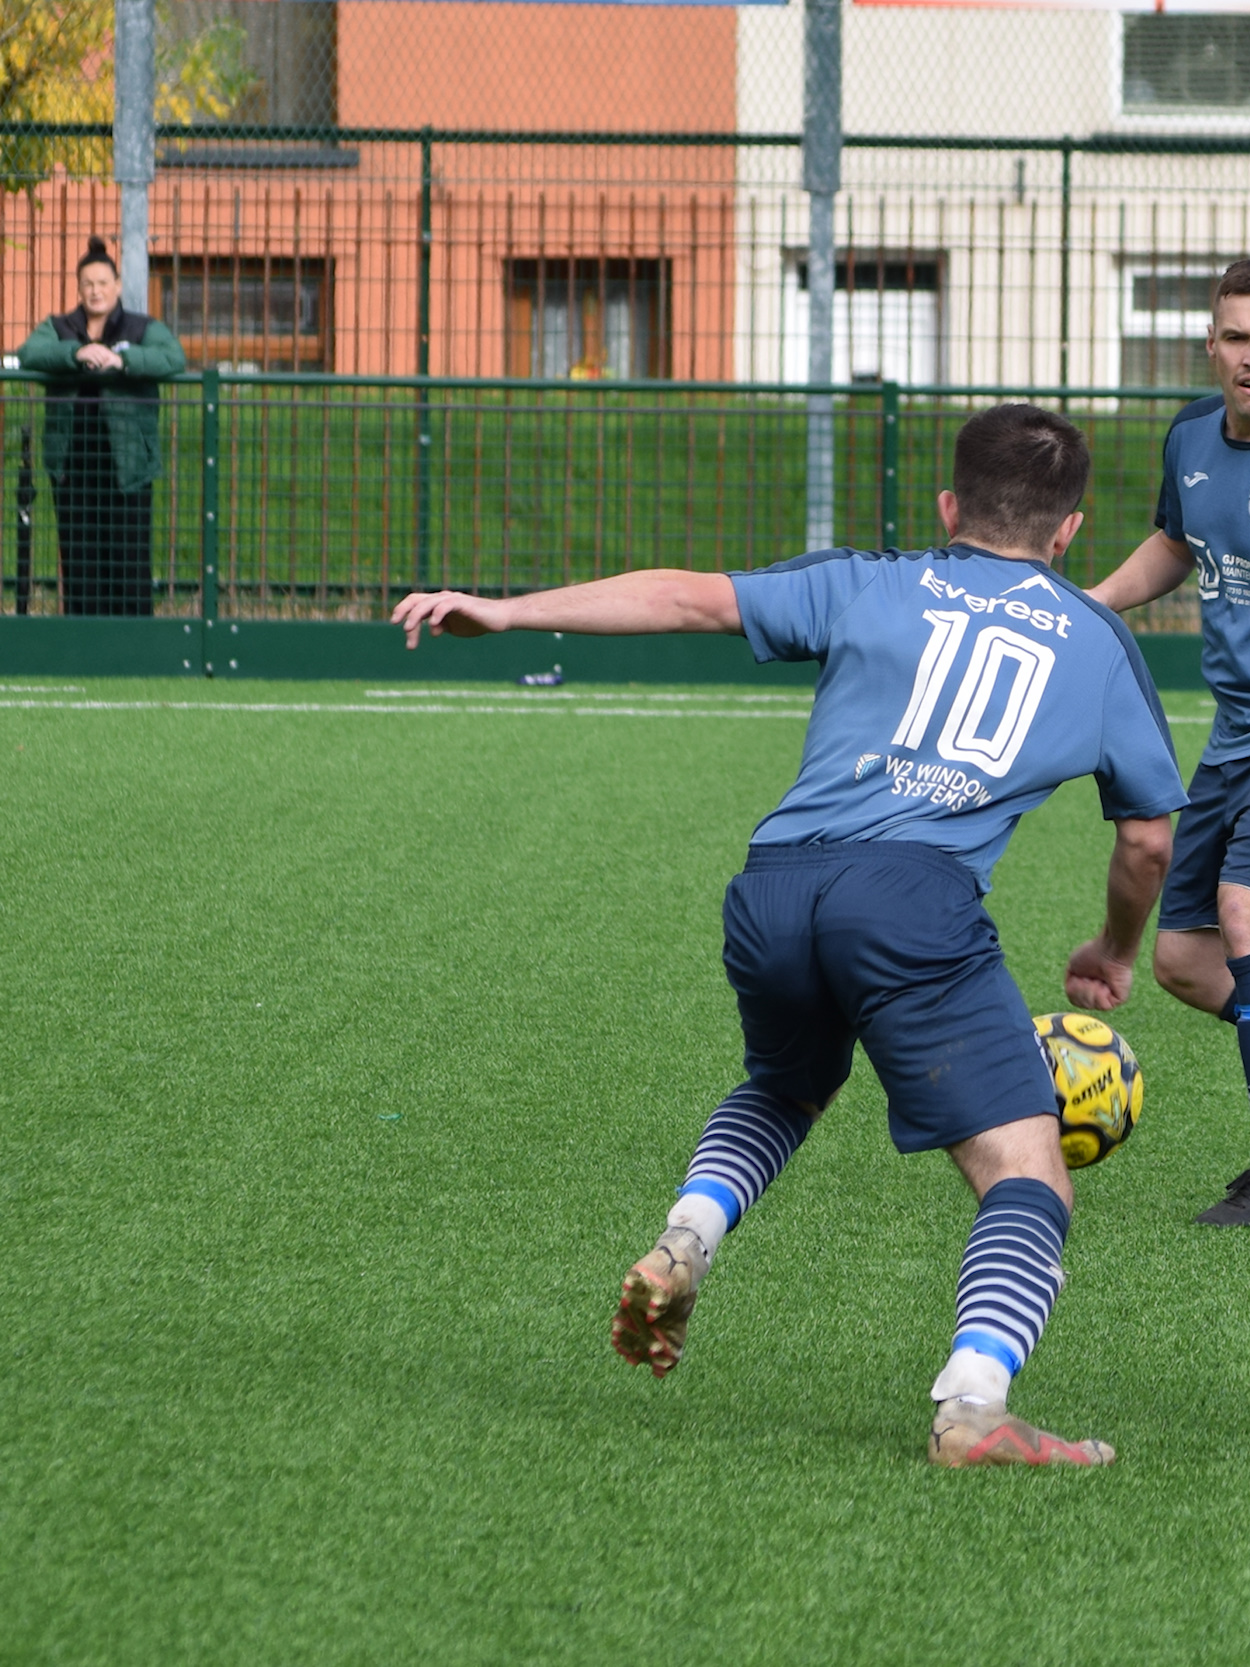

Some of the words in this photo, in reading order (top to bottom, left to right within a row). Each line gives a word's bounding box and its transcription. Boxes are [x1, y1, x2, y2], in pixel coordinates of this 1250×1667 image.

[1222, 554, 1235, 566] GJ
[919, 567, 1073, 639] Everest
[890, 608, 1056, 779] 10
[885, 754, 914, 777] W2
[916, 764, 992, 808] WINDOW
[891, 776, 967, 812] SYSTEMS
